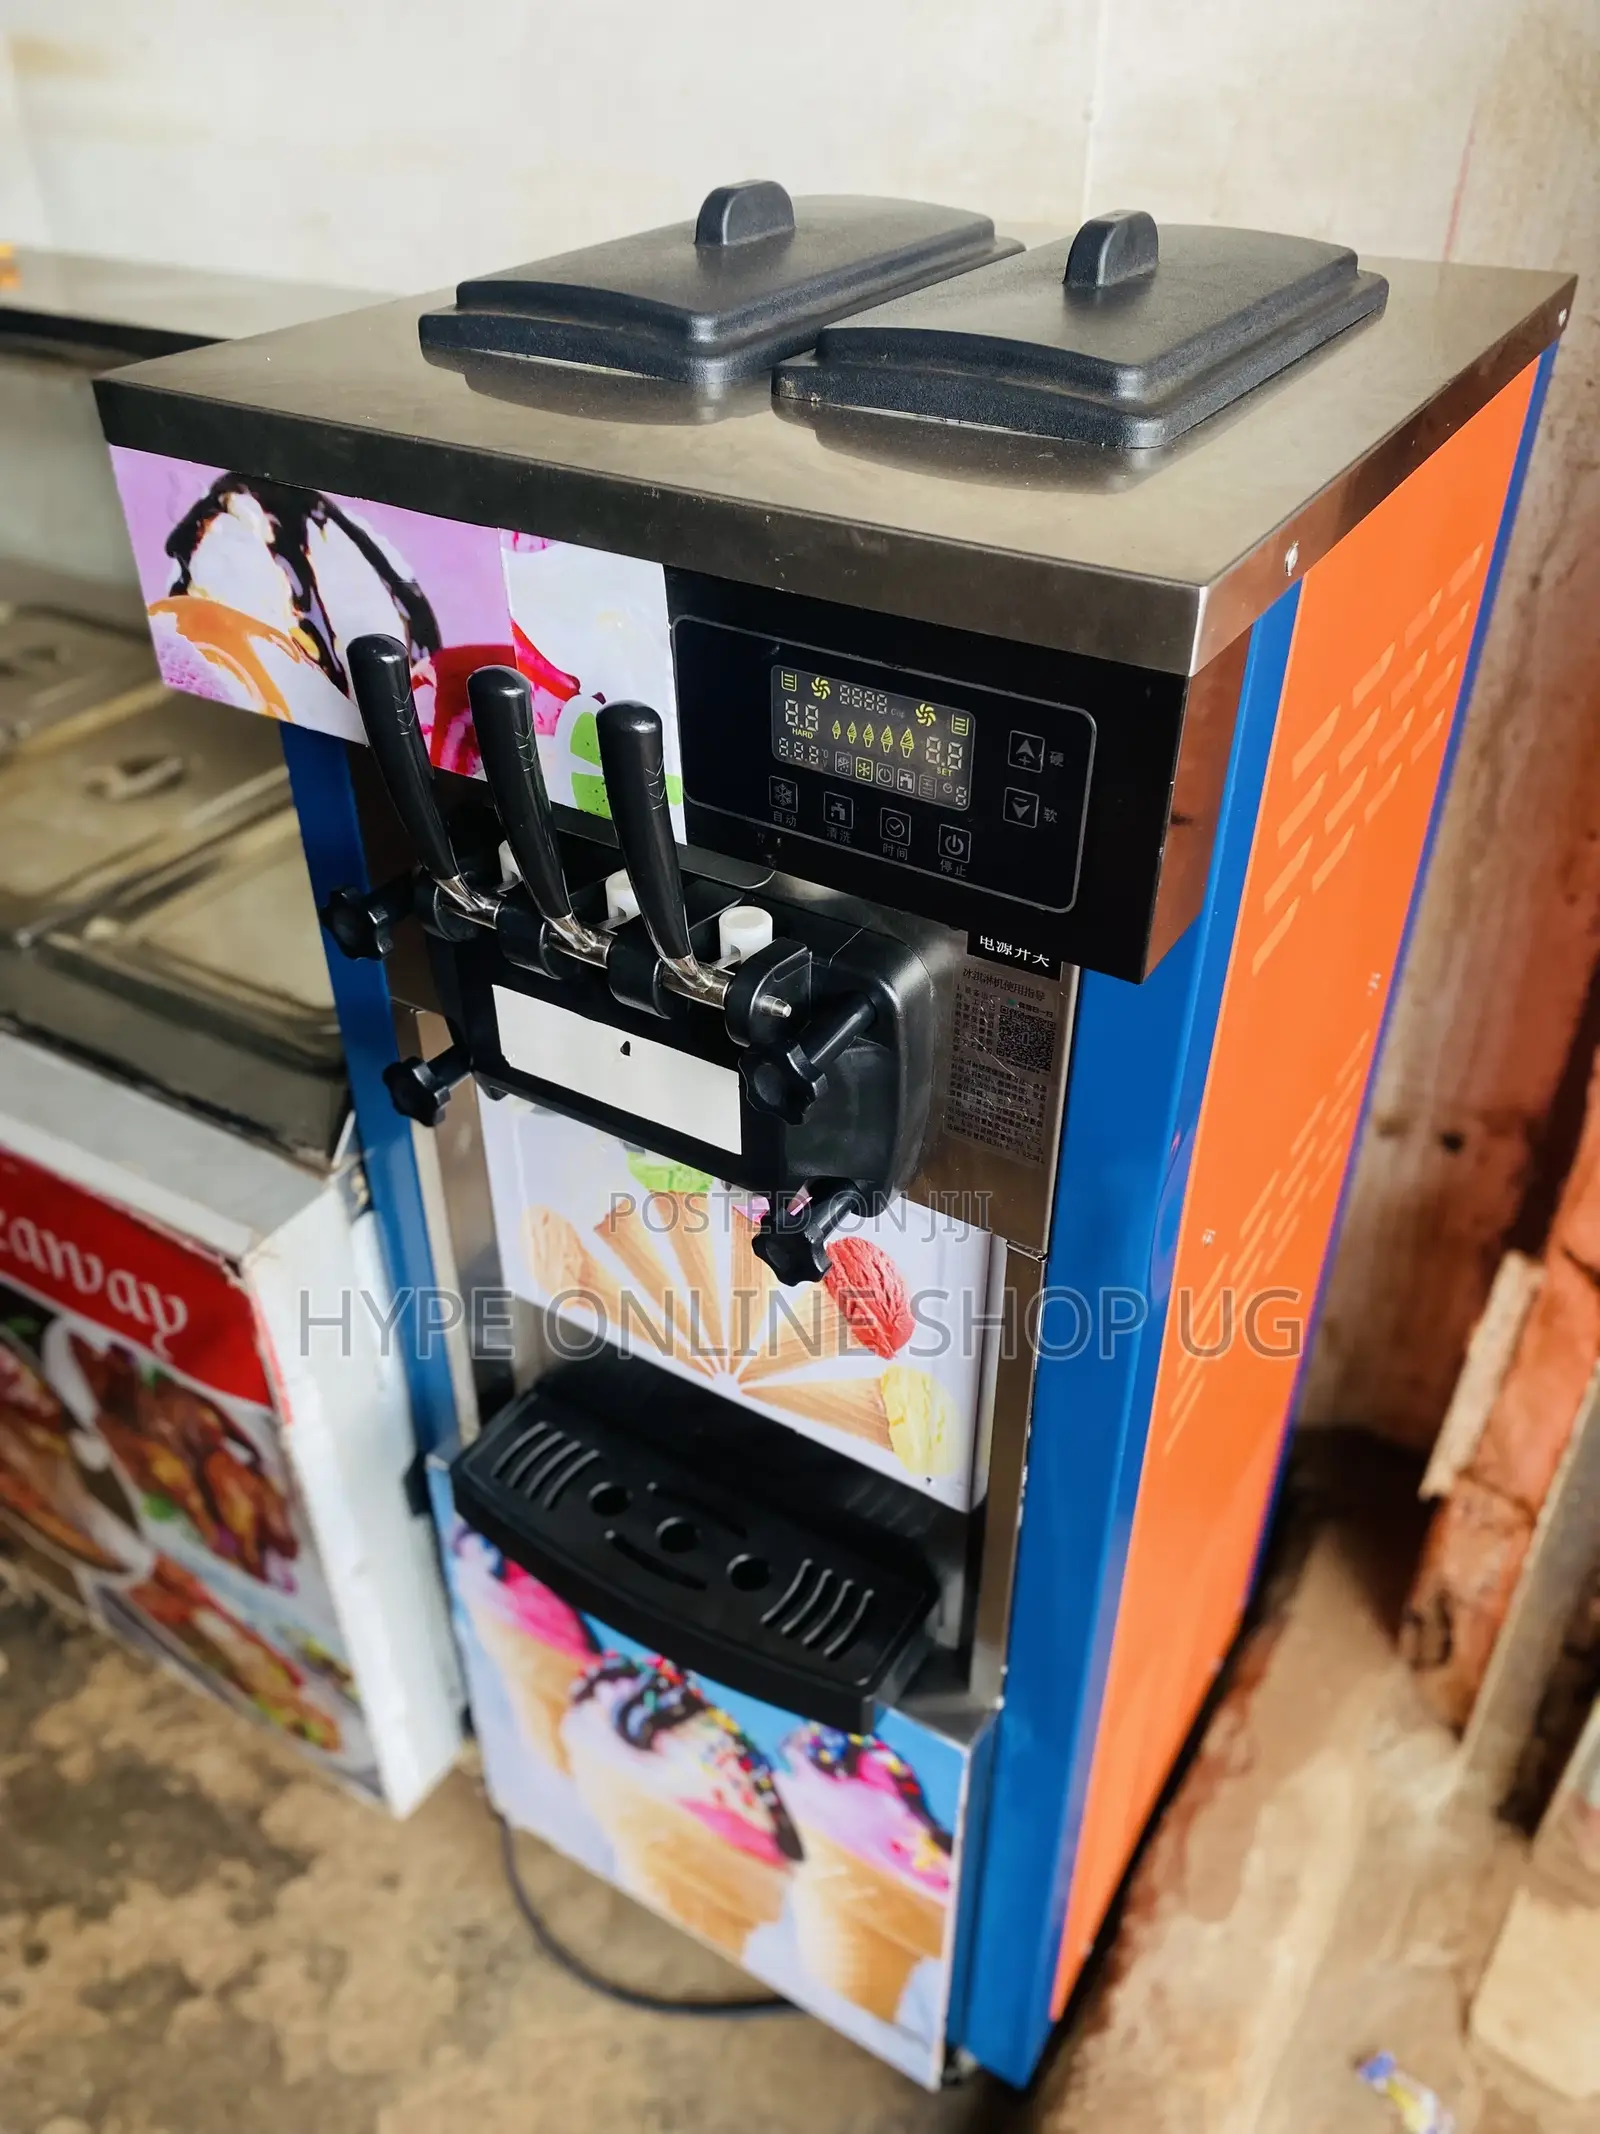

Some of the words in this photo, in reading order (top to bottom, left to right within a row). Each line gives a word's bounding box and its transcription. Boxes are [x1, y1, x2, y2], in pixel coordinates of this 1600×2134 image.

[791, 727, 814, 740] HARD
[936, 765, 953, 777] SET
[773, 811, 797, 828] 自动
[1043, 806, 1058, 823] 软
[826, 826, 851, 844] 清洗
[882, 843, 909, 861] 时间
[939, 859, 967, 878] 停止
